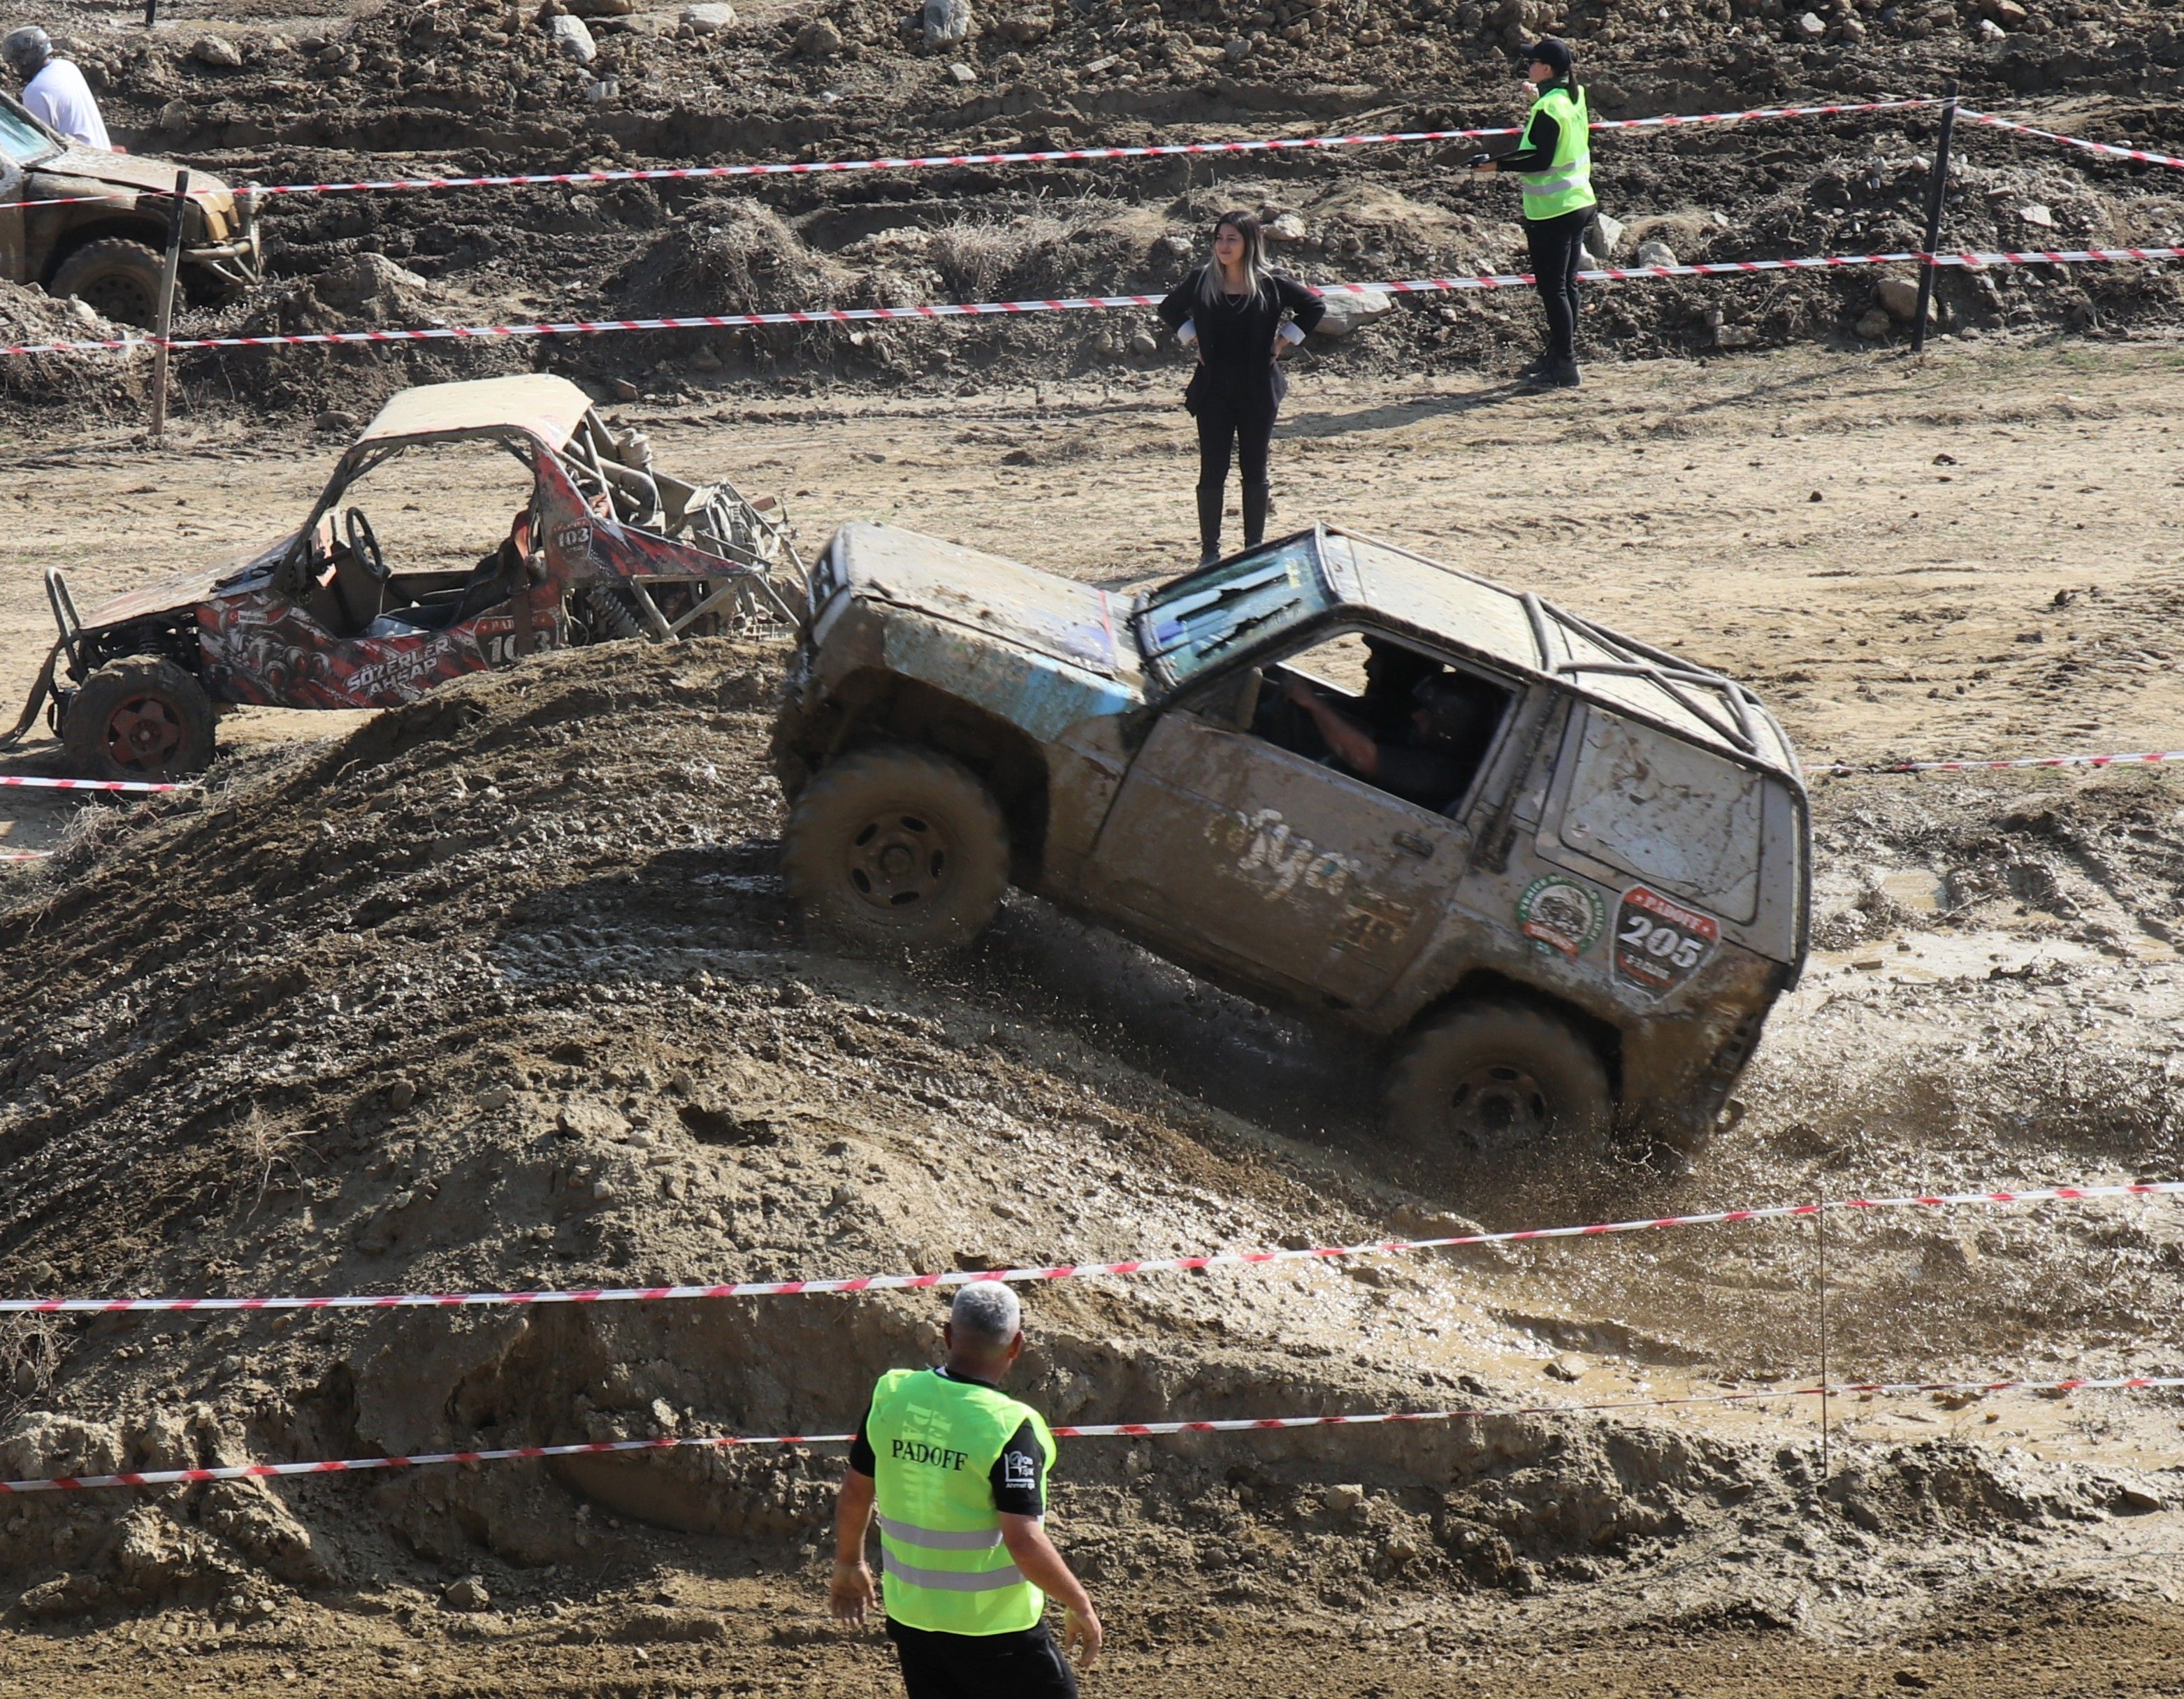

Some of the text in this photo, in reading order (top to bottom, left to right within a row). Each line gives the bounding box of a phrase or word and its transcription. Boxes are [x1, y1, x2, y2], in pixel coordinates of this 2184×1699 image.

[558, 528, 589, 548] 103
[1618, 916, 1705, 969] 205
[892, 1440, 969, 1471] PADOFF
